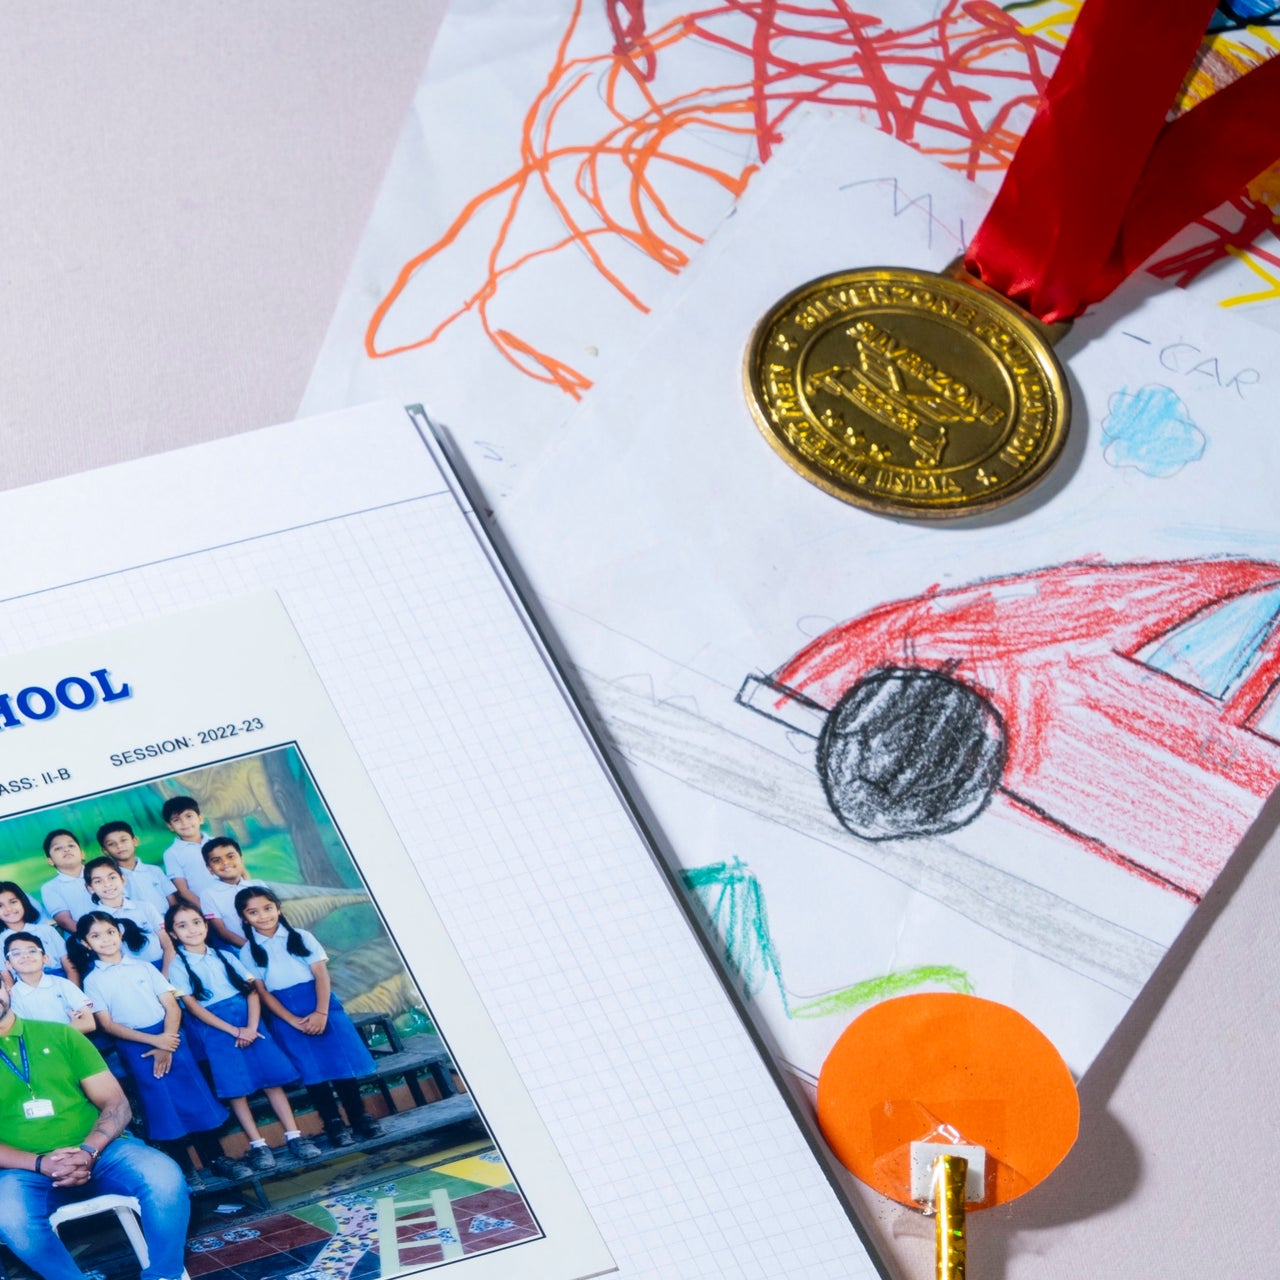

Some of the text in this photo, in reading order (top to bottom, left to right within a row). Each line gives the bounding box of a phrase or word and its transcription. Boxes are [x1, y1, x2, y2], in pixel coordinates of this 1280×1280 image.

[795, 285, 978, 331] SILVERZONE
[974, 323, 1046, 469] FOUNDATION
[846, 320, 1006, 426] SILVERZONE
[769, 362, 805, 418] NEW
[875, 470, 964, 494] INDIA
[42, 768, 70, 784] II-B
[110, 718, 263, 766] SESSION: 2022-23
